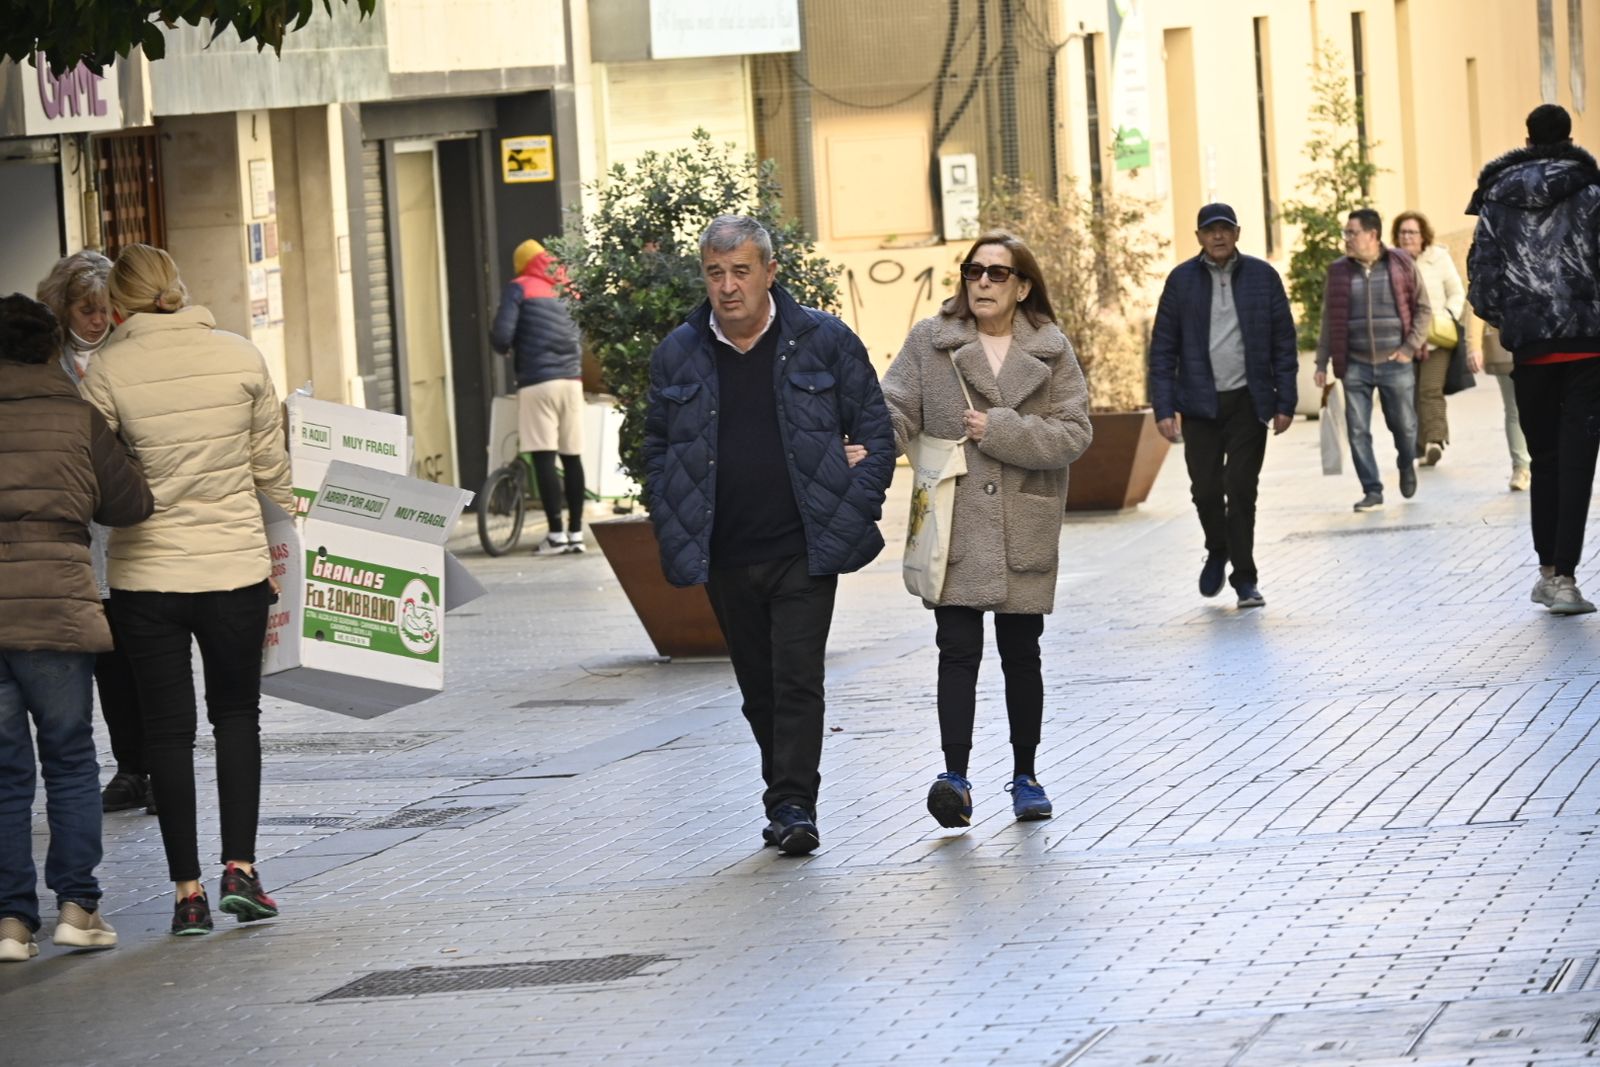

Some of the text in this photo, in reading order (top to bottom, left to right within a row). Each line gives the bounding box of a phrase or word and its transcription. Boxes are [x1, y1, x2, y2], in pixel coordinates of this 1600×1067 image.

[342, 435, 398, 457] MUY FRAGIL
[323, 490, 348, 505] ABRIR
[347, 495, 364, 508] POR
[394, 506, 447, 528] MUY FRAGIL
[269, 543, 289, 561] NAS
[312, 555, 386, 590] GRANJAS
[327, 587, 396, 623] ZAMBRANO
[266, 610, 291, 630] CCION
